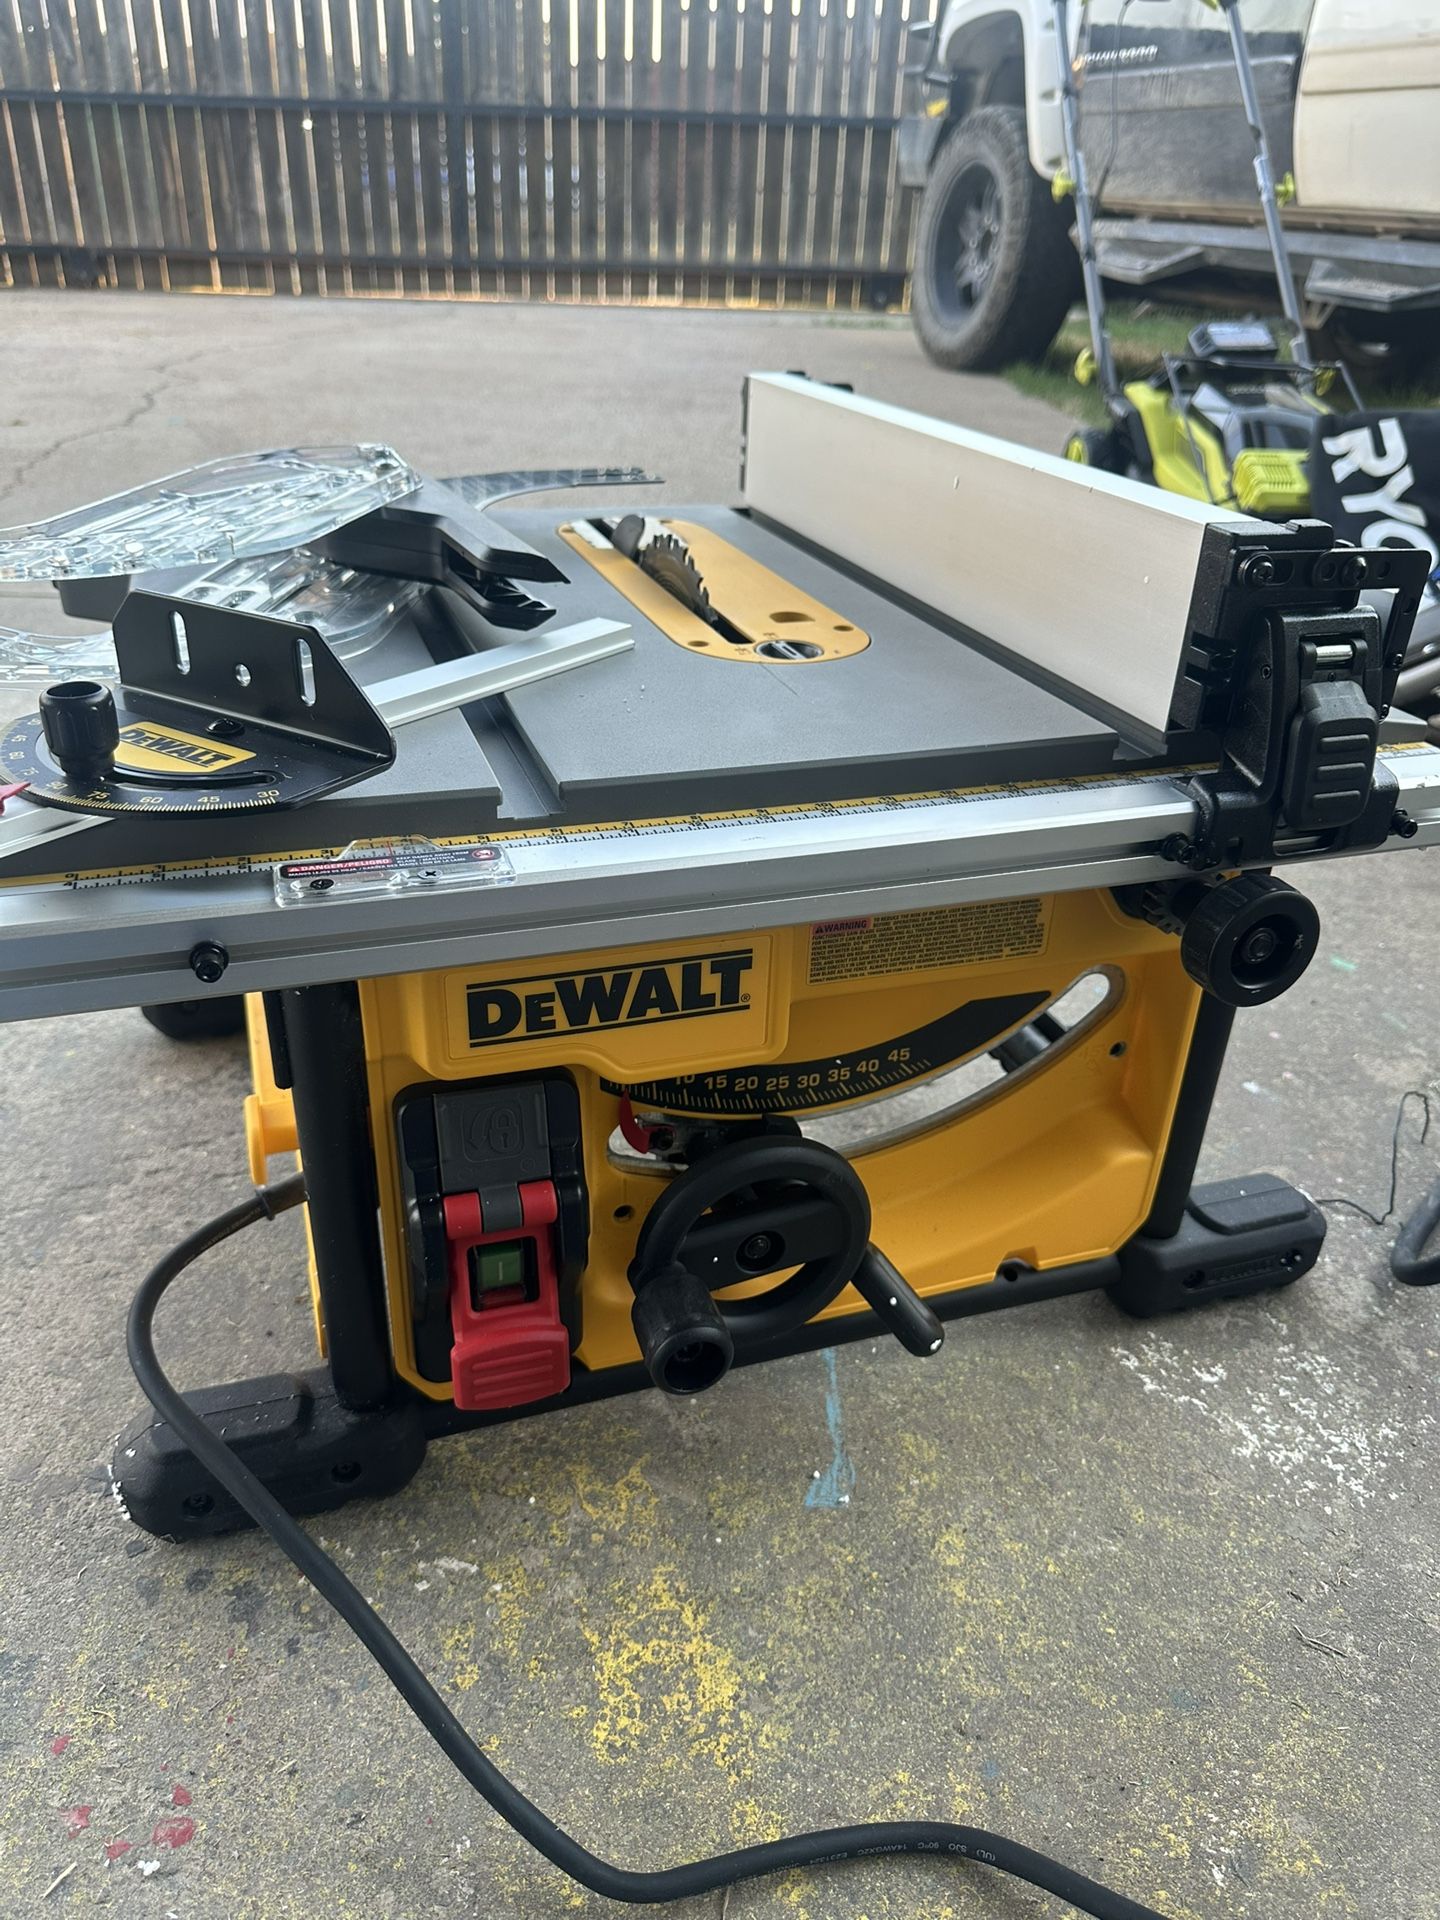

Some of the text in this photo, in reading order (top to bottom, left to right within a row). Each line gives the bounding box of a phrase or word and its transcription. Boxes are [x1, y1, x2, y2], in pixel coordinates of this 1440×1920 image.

[87, 789, 280, 804] 75 60 45 30
[300, 859, 390, 872] DANGER/PELIGRO
[825, 920, 867, 933] WARNING
[704, 1076, 727, 1090] 15
[734, 1077, 758, 1091] 20
[766, 1076, 789, 1091] 25
[797, 1074, 820, 1088] 30
[827, 1067, 851, 1083] 35
[856, 1059, 880, 1073] 40
[888, 1048, 911, 1061] 45
[948, 1842, 968, 1854] SJO
[976, 1849, 996, 1862] (UL)
